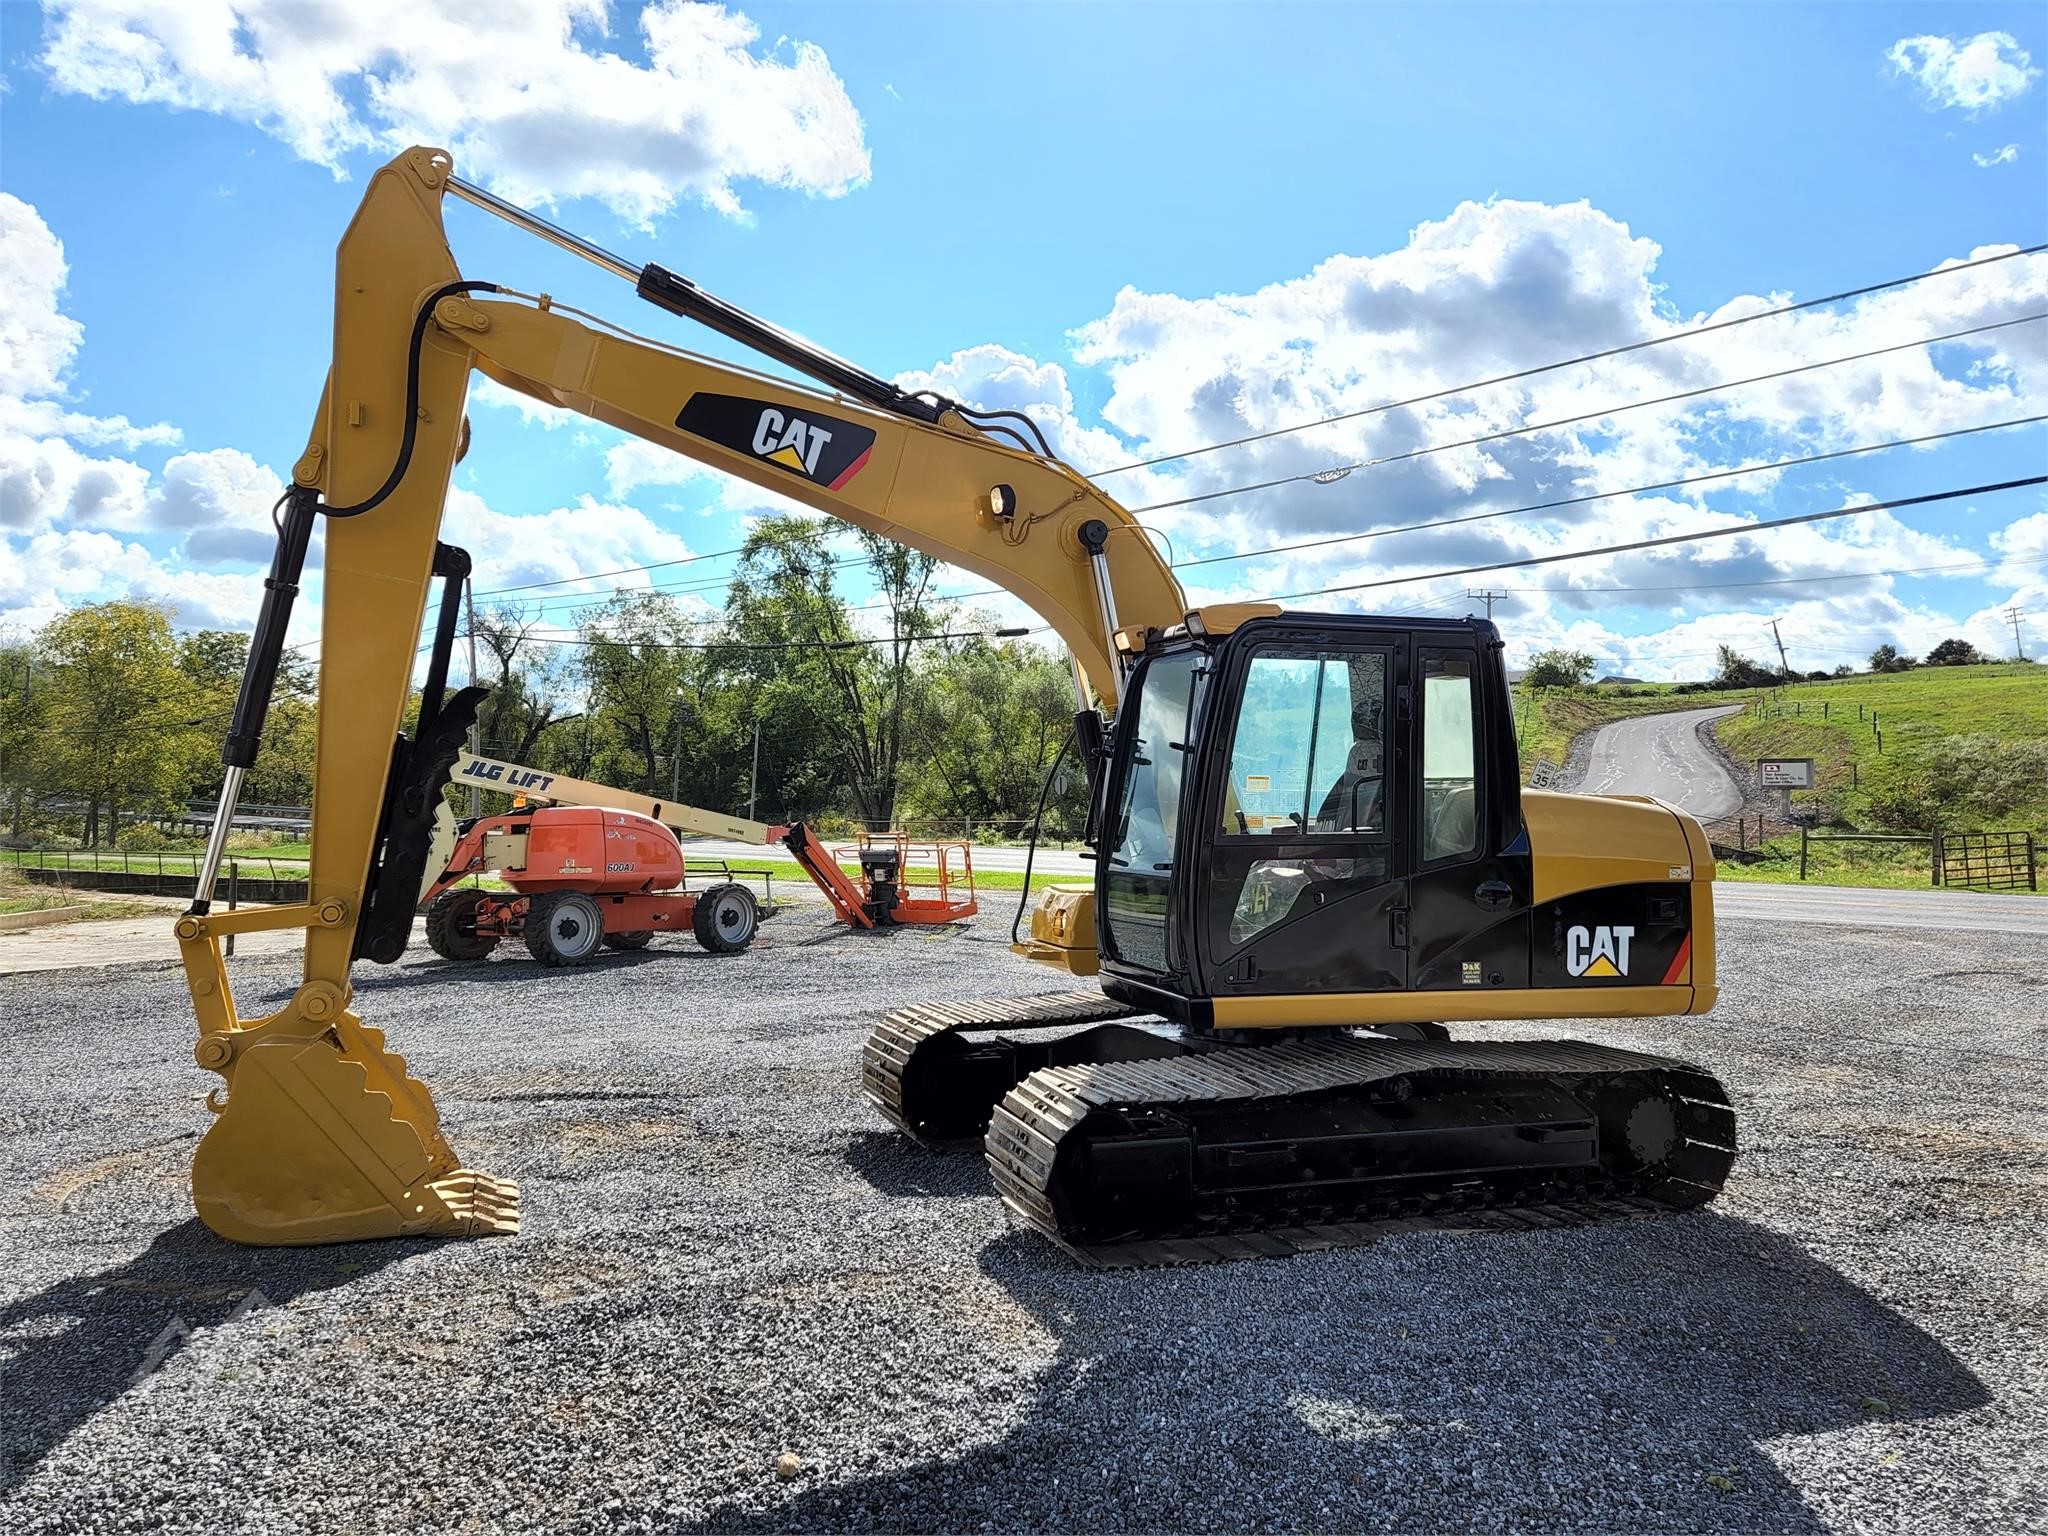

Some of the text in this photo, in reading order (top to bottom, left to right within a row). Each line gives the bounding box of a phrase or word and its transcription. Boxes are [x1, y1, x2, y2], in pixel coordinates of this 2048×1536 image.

[751, 408, 833, 476] CAT
[1539, 762, 1555, 771] SPEED
[461, 760, 554, 791] JLG LIFT
[1532, 773, 1549, 787] 35
[607, 863, 635, 873] 600AJ
[1566, 925, 1635, 977] CAT
[1462, 961, 1481, 970] D&K
